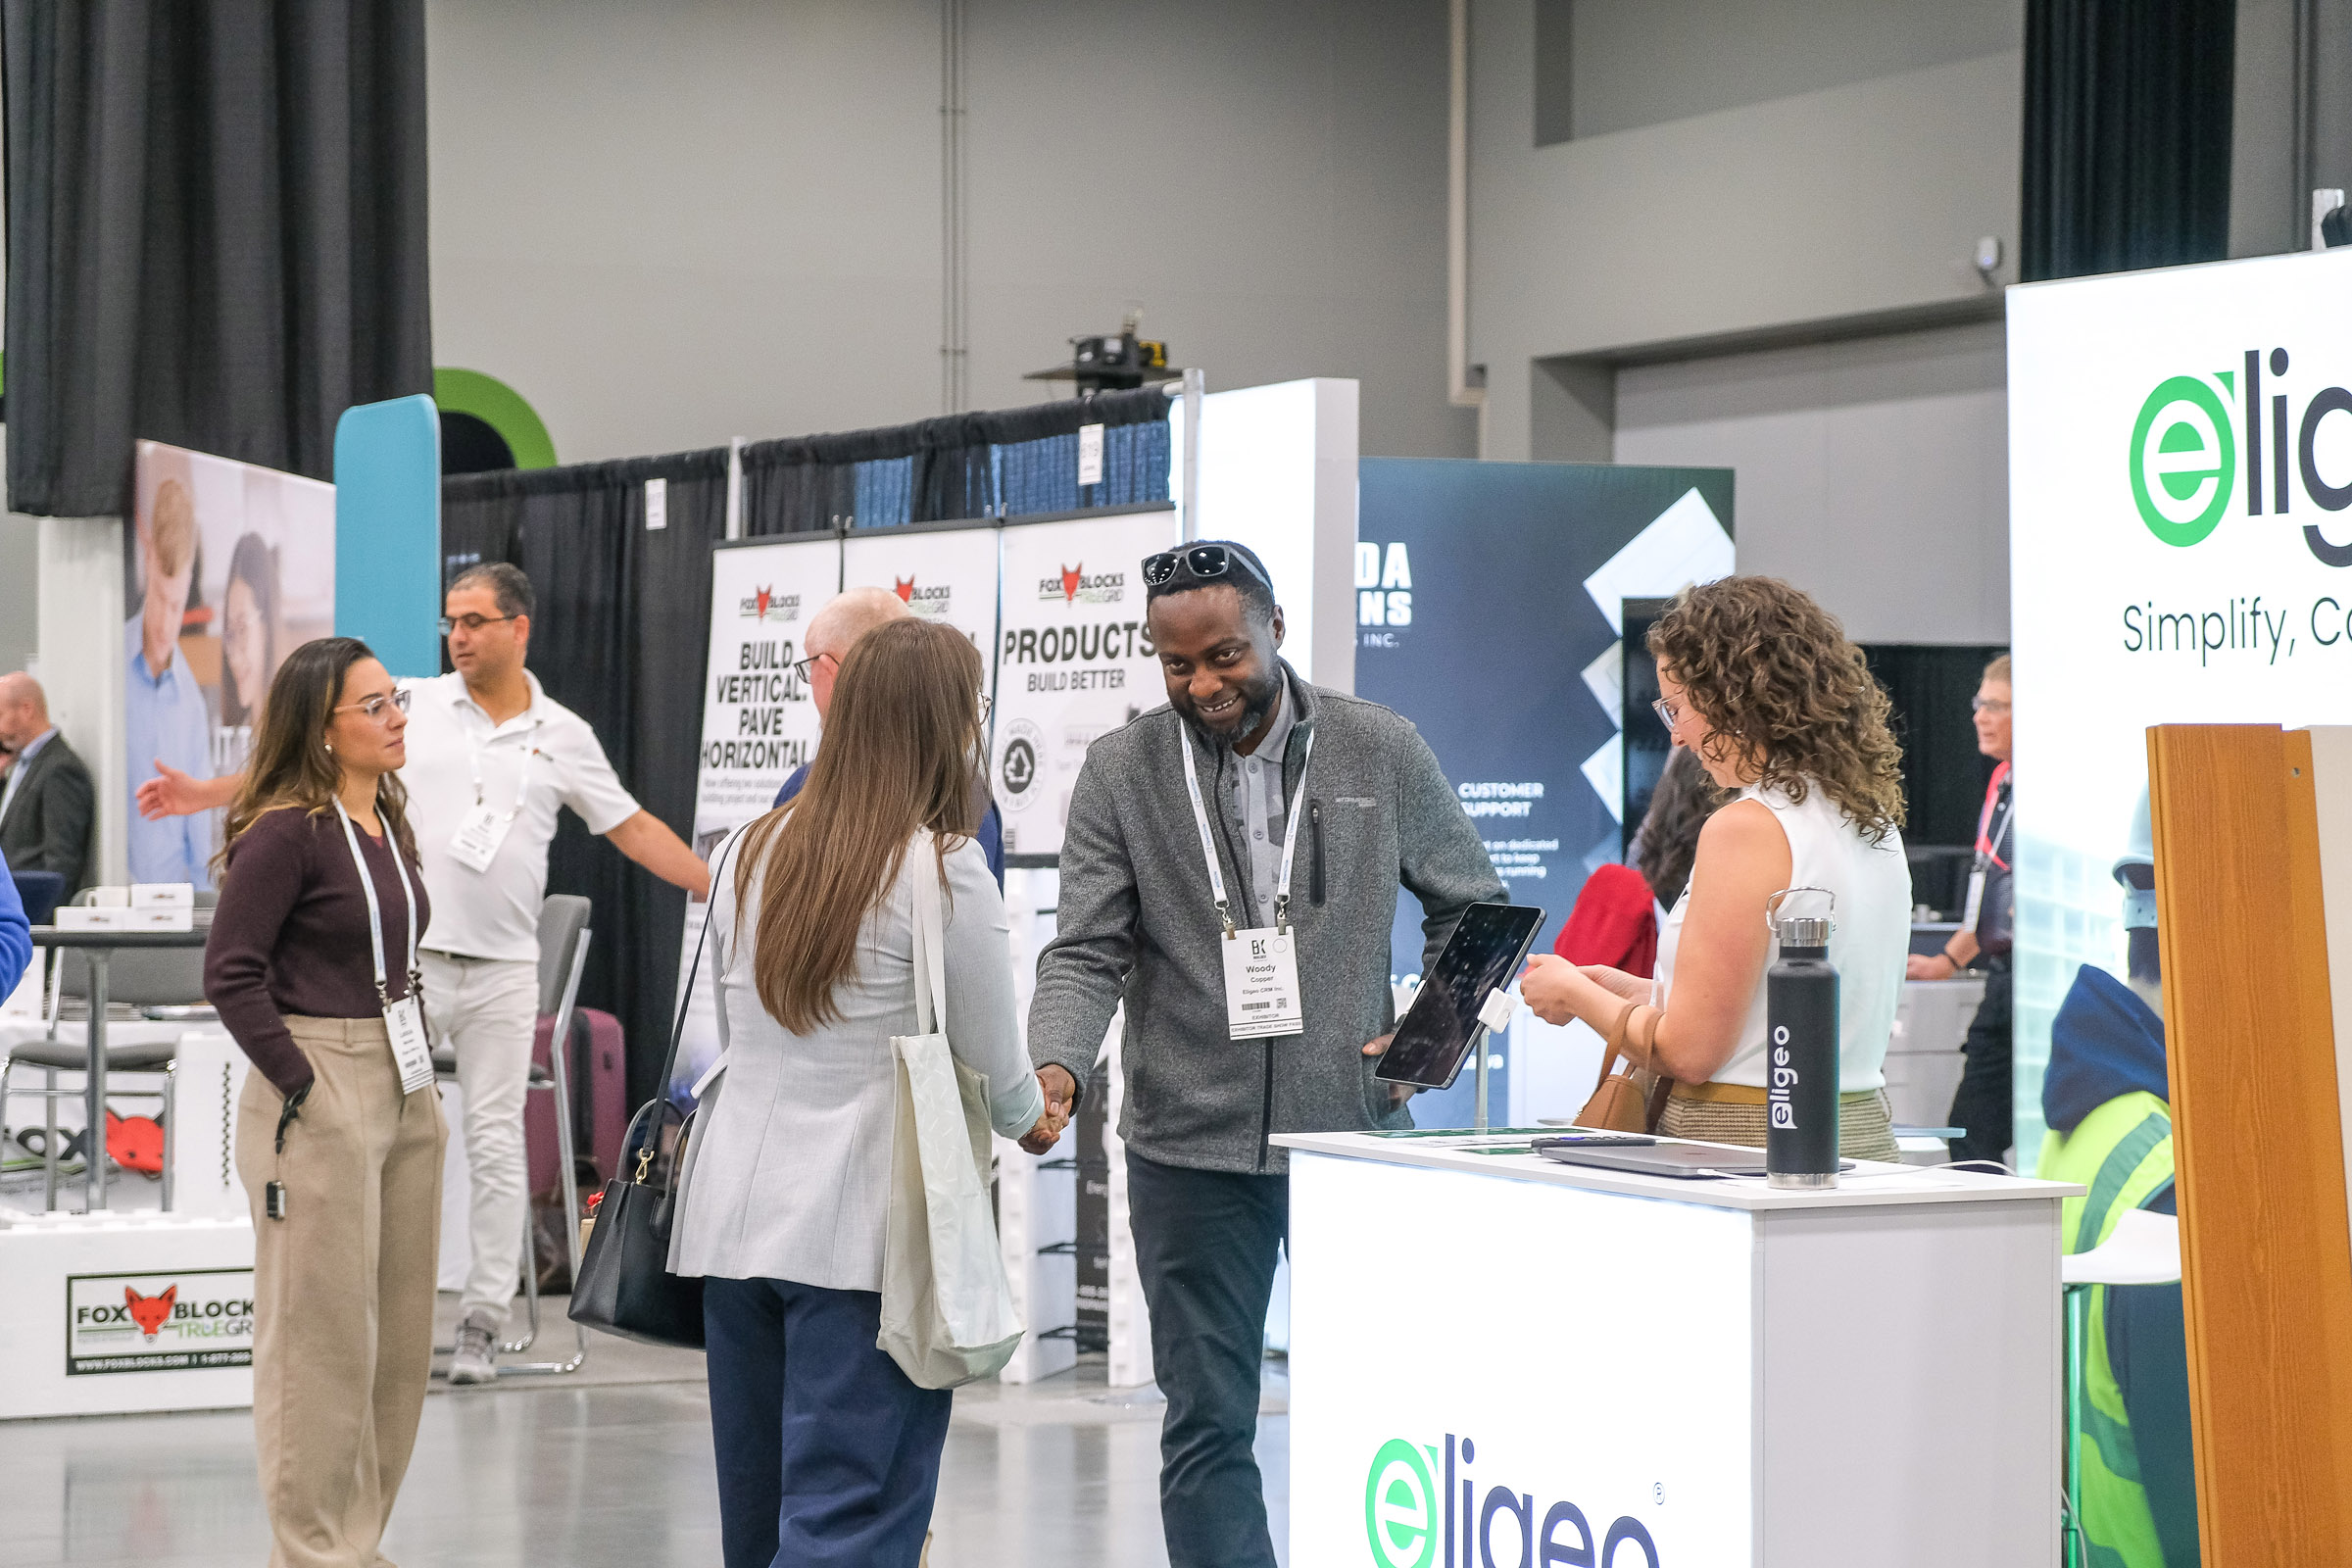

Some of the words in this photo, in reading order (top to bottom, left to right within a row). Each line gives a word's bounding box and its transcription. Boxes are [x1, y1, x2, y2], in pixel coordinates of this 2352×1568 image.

[1039, 578, 1062, 593] FOX
[1079, 573, 1125, 588] BLOCKS
[1363, 633, 1399, 648] INC.
[2124, 596, 2295, 667] Simplify,
[2311, 596, 2352, 647] C
[1003, 621, 1155, 665] PRODUCTS
[740, 641, 794, 670] BUILD
[716, 674, 808, 704] VERTICAL.
[1026, 670, 1068, 692] BUILD
[1071, 668, 1126, 690] BETTER
[739, 707, 785, 735] PAVE
[1457, 782, 1544, 799] CUSTOMER
[1506, 866, 1547, 879] running
[1246, 964, 1277, 973] Woody
[1769, 1025, 1799, 1130] eligeo
[77, 1306, 127, 1323] FOX
[75, 1356, 190, 1371] WWW.FOXBLOCKS.COM
